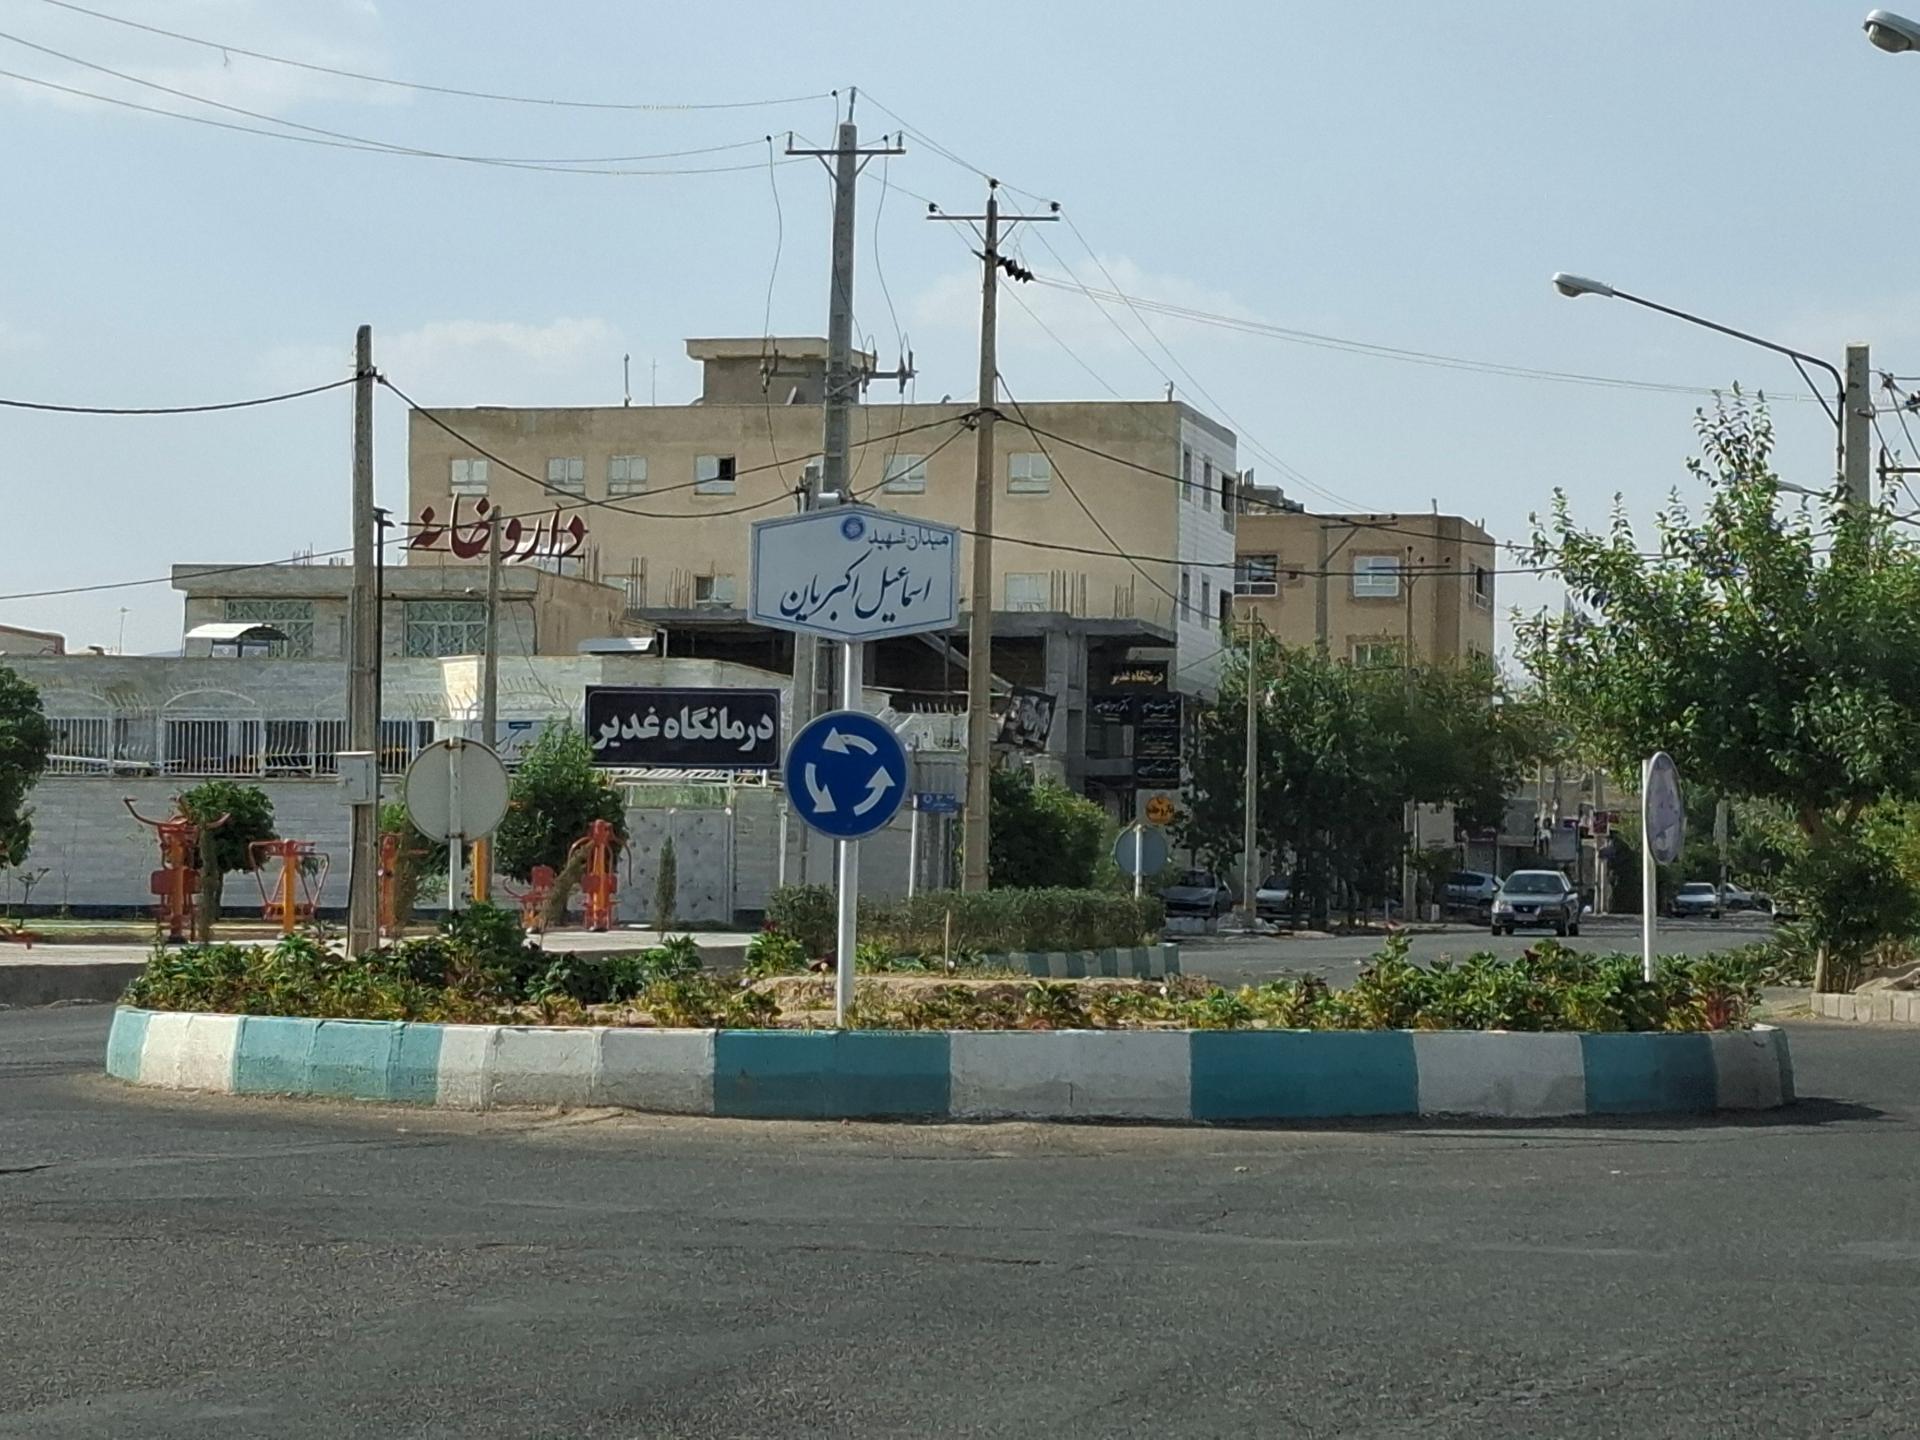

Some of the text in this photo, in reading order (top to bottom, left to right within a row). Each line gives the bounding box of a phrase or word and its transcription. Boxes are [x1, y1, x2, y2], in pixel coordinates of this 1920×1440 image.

[410, 492, 585, 563] داروخانه
[868, 526, 949, 550] میدان شهید
[779, 547, 932, 623] اسماعیل اکبریان
[592, 704, 774, 752] درمانگاه غدیر
